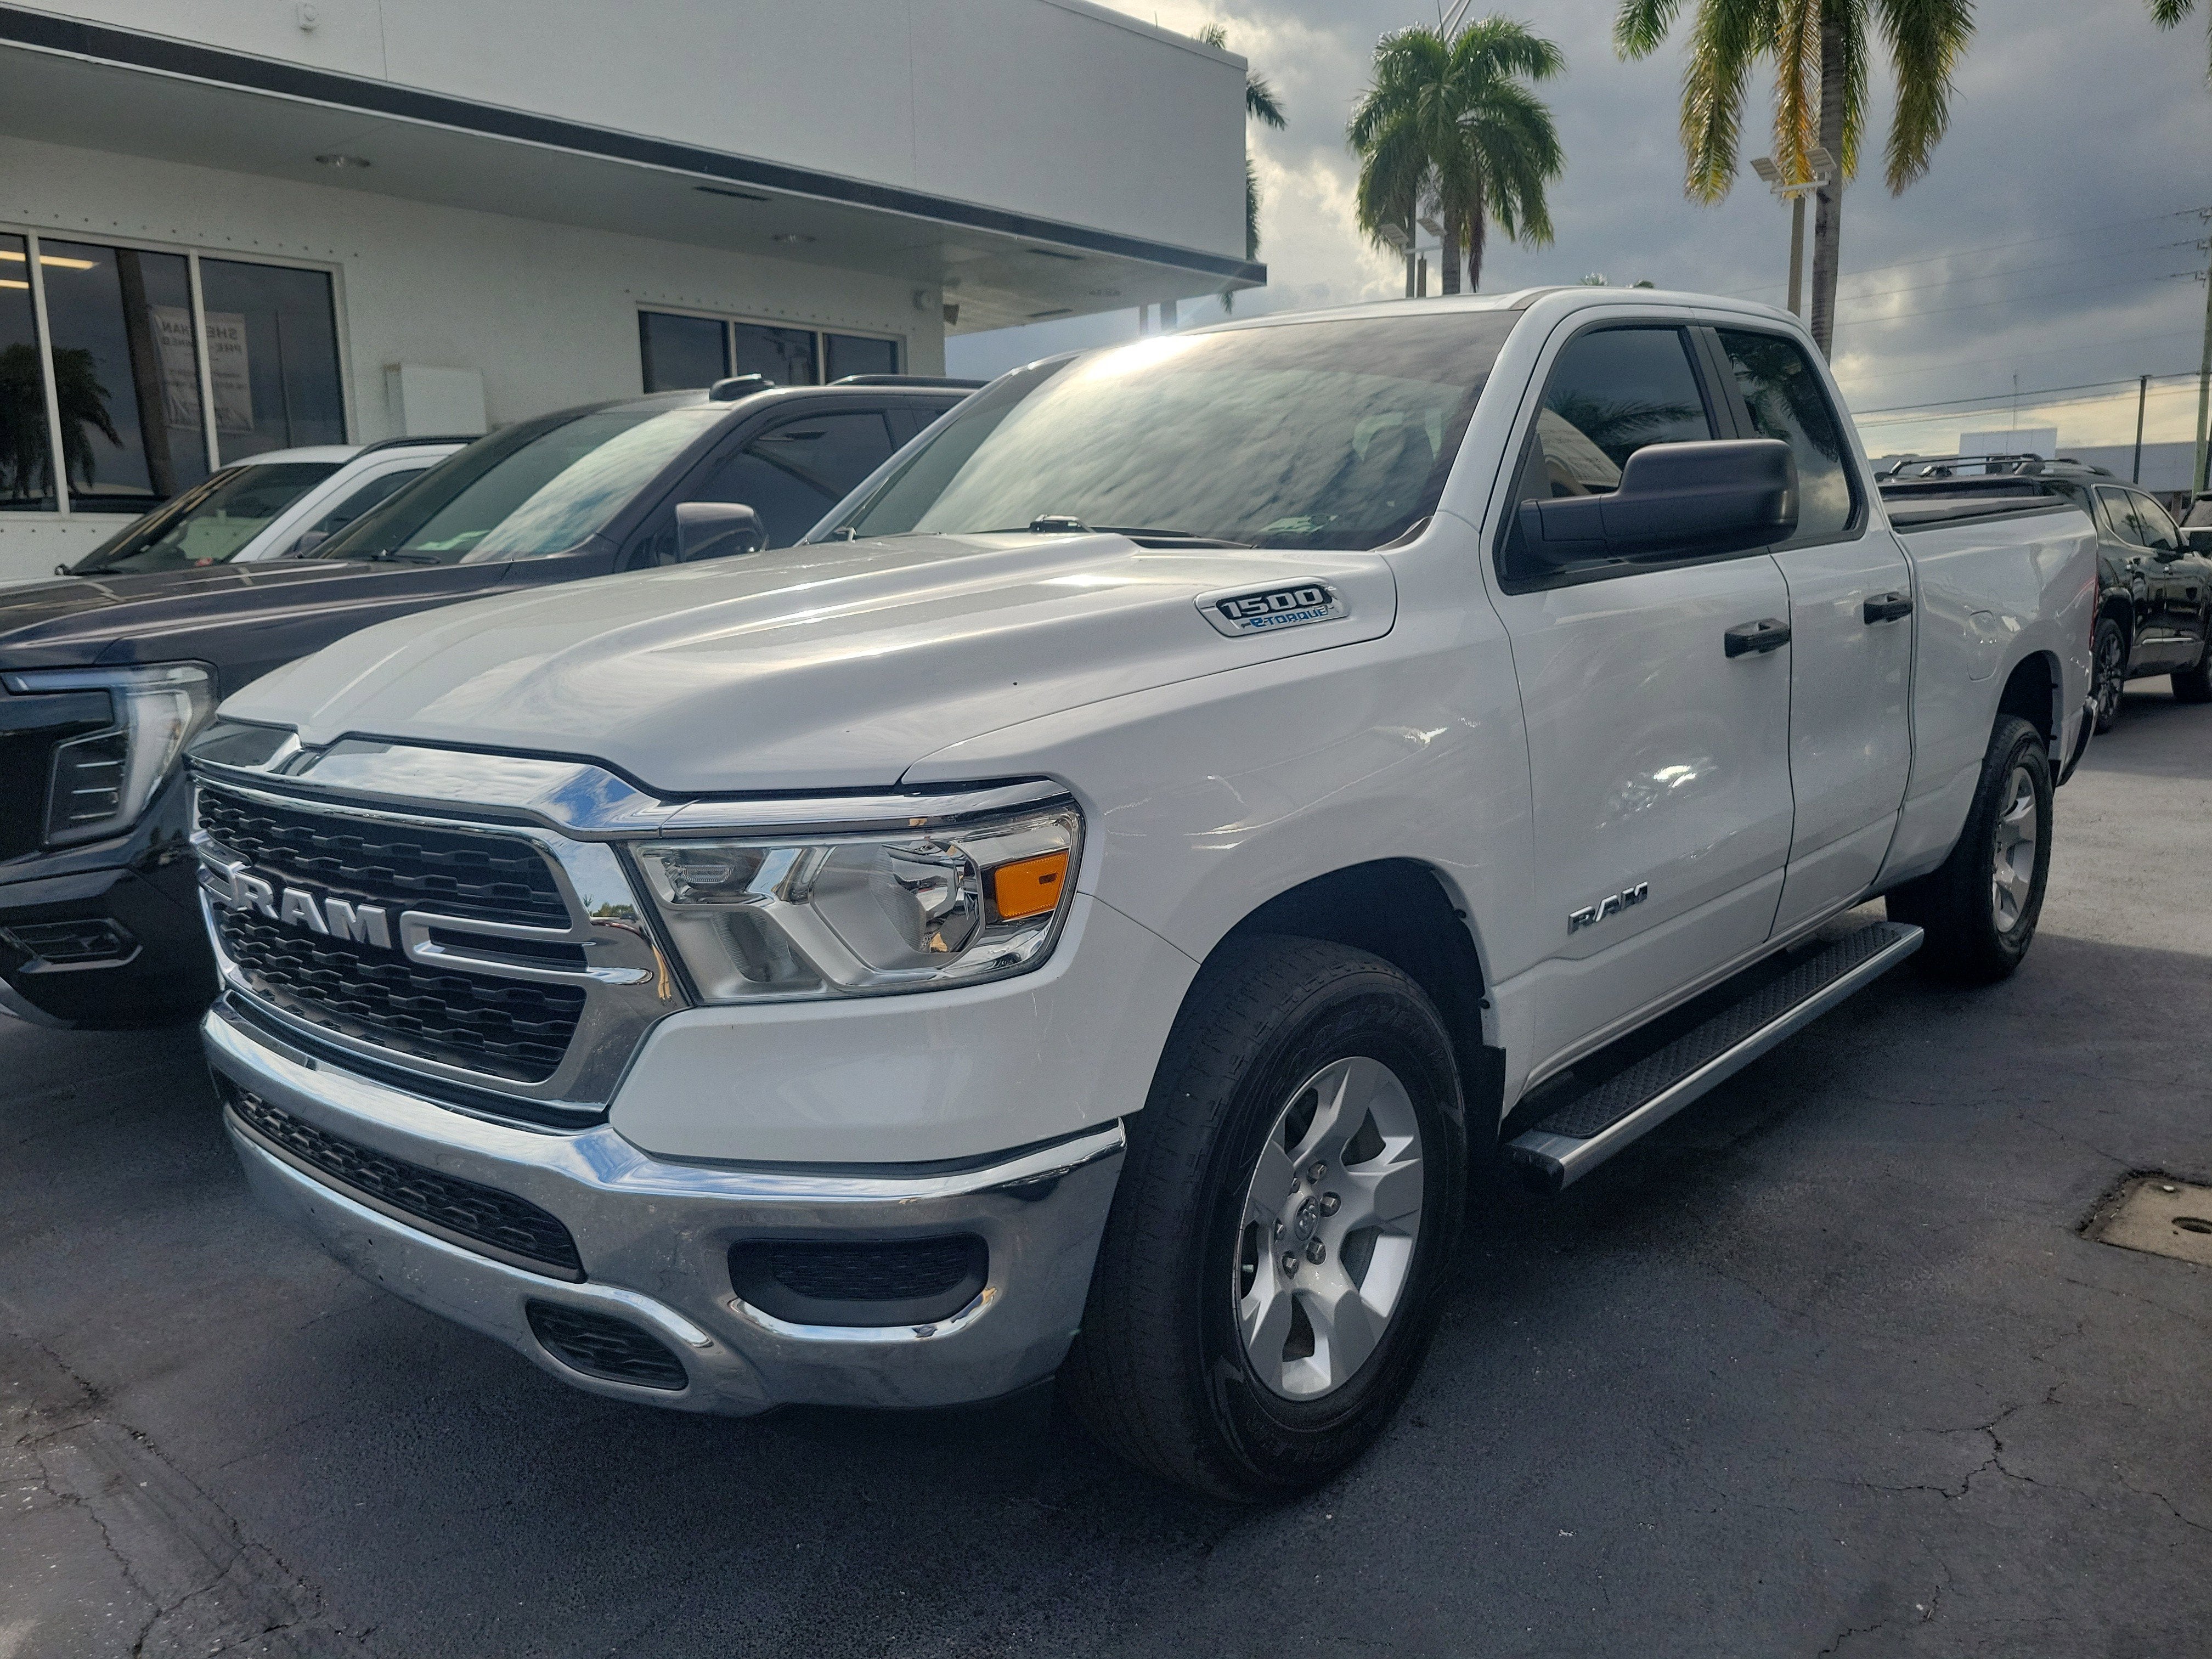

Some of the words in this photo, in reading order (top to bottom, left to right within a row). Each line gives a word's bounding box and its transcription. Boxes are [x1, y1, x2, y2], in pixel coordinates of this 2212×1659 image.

[1221, 588, 1324, 618] 1500
[233, 871, 392, 949] RAM
[1567, 881, 1649, 935] RAM
